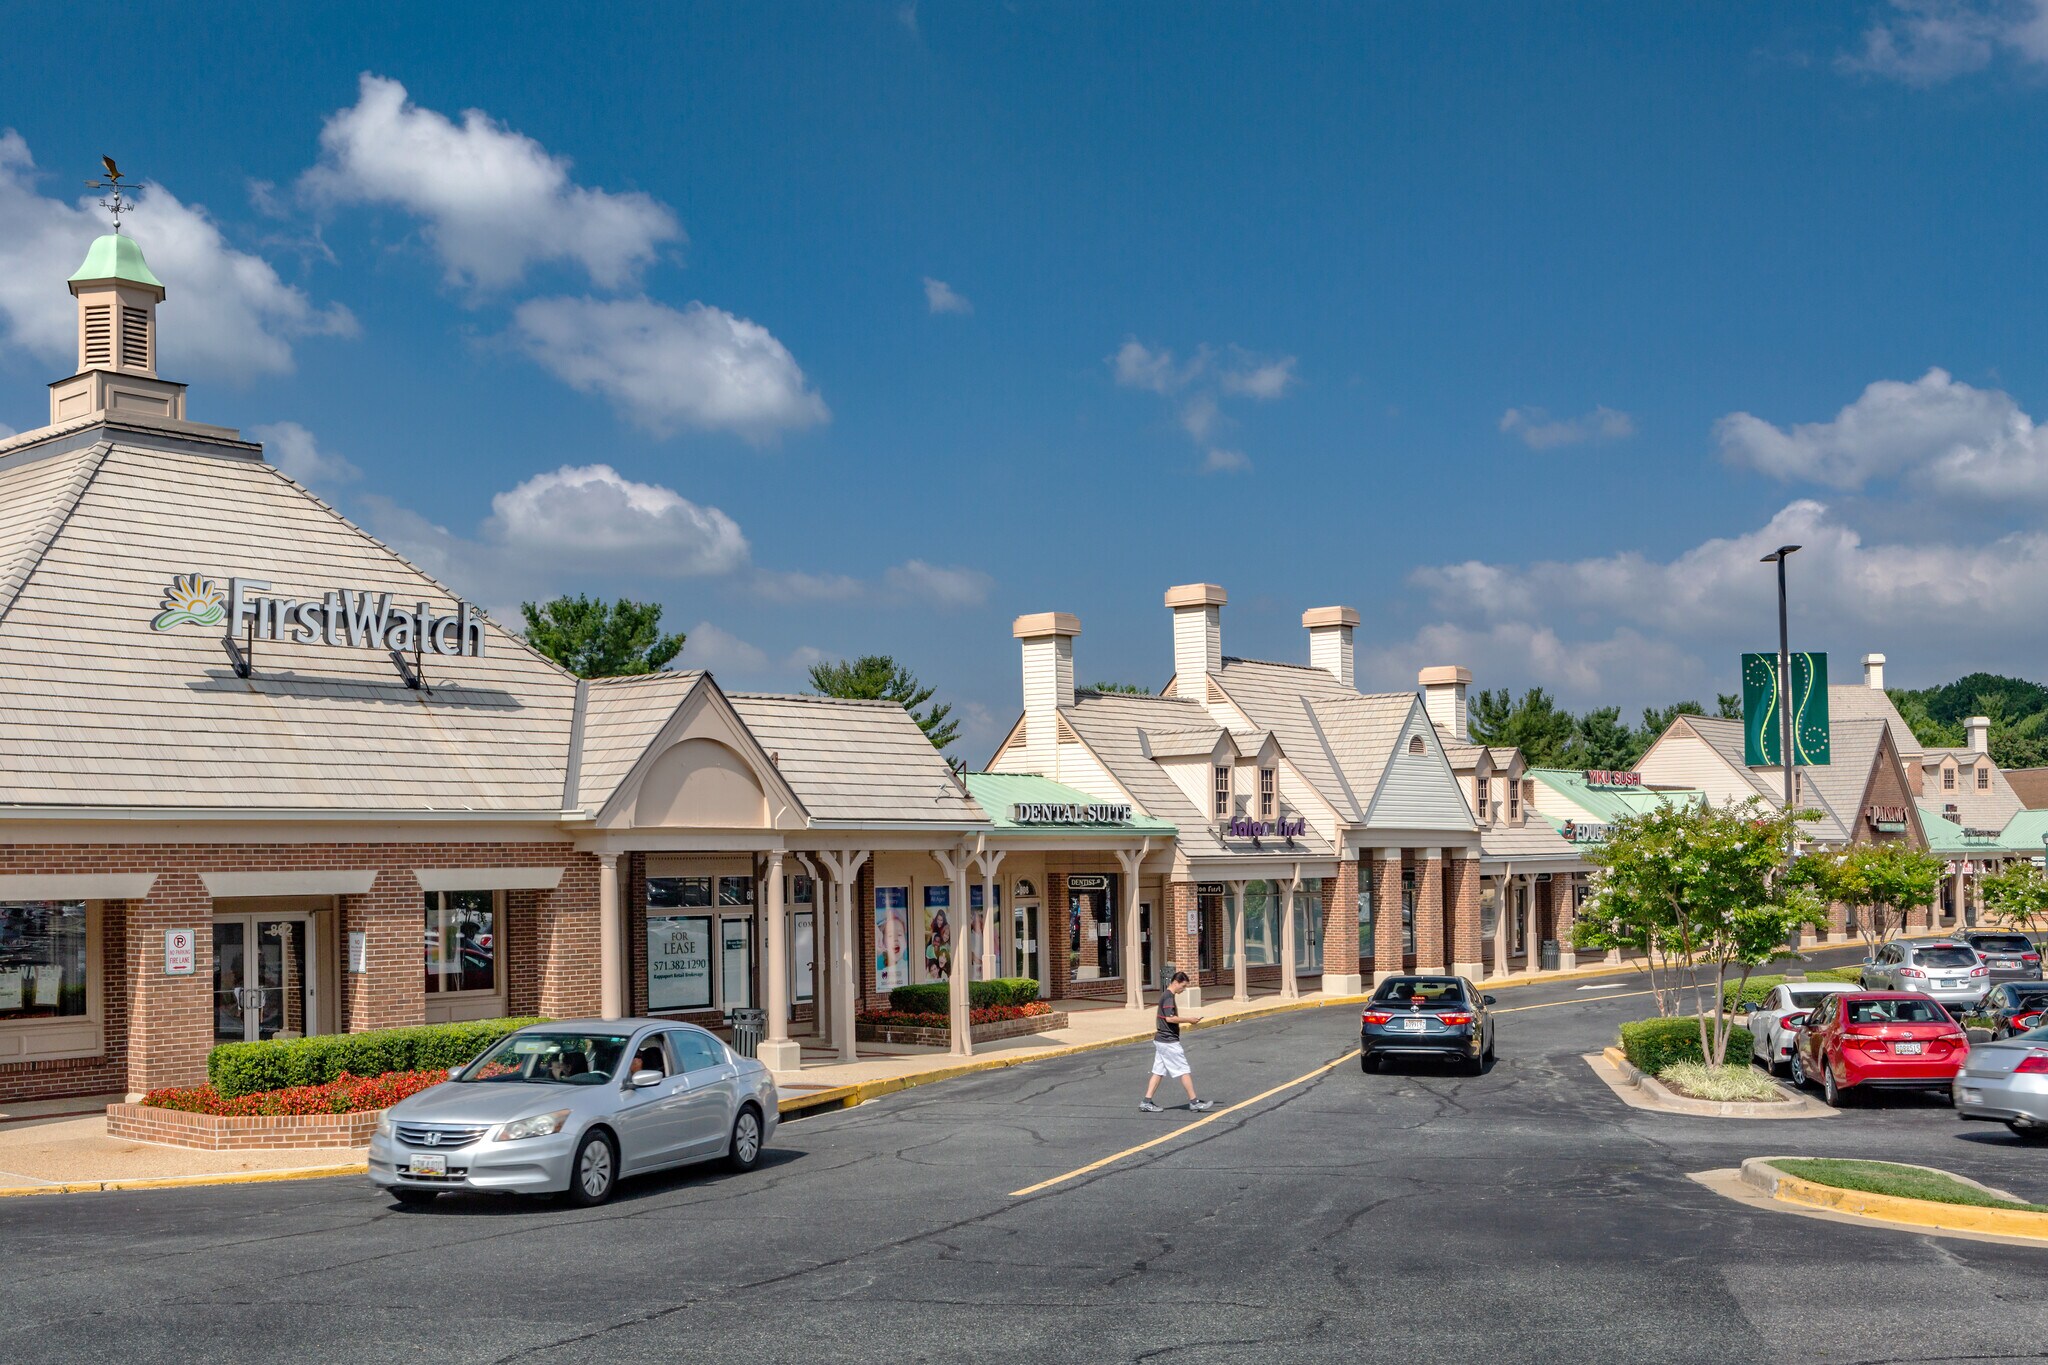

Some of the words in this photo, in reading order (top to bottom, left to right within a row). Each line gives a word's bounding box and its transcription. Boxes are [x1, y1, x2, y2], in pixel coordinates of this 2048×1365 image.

[1588, 770, 1611, 785] YIKU
[1613, 771, 1641, 786] SUSHI
[1018, 803, 1084, 822] DENTAL
[1087, 804, 1133, 822] SUITE
[1230, 816, 1270, 836] Salon
[1071, 879, 1097, 887] DENTIST
[671, 932, 689, 941] FOR
[664, 942, 696, 955] LEASE
[653, 959, 706, 971] 571.382.1290
